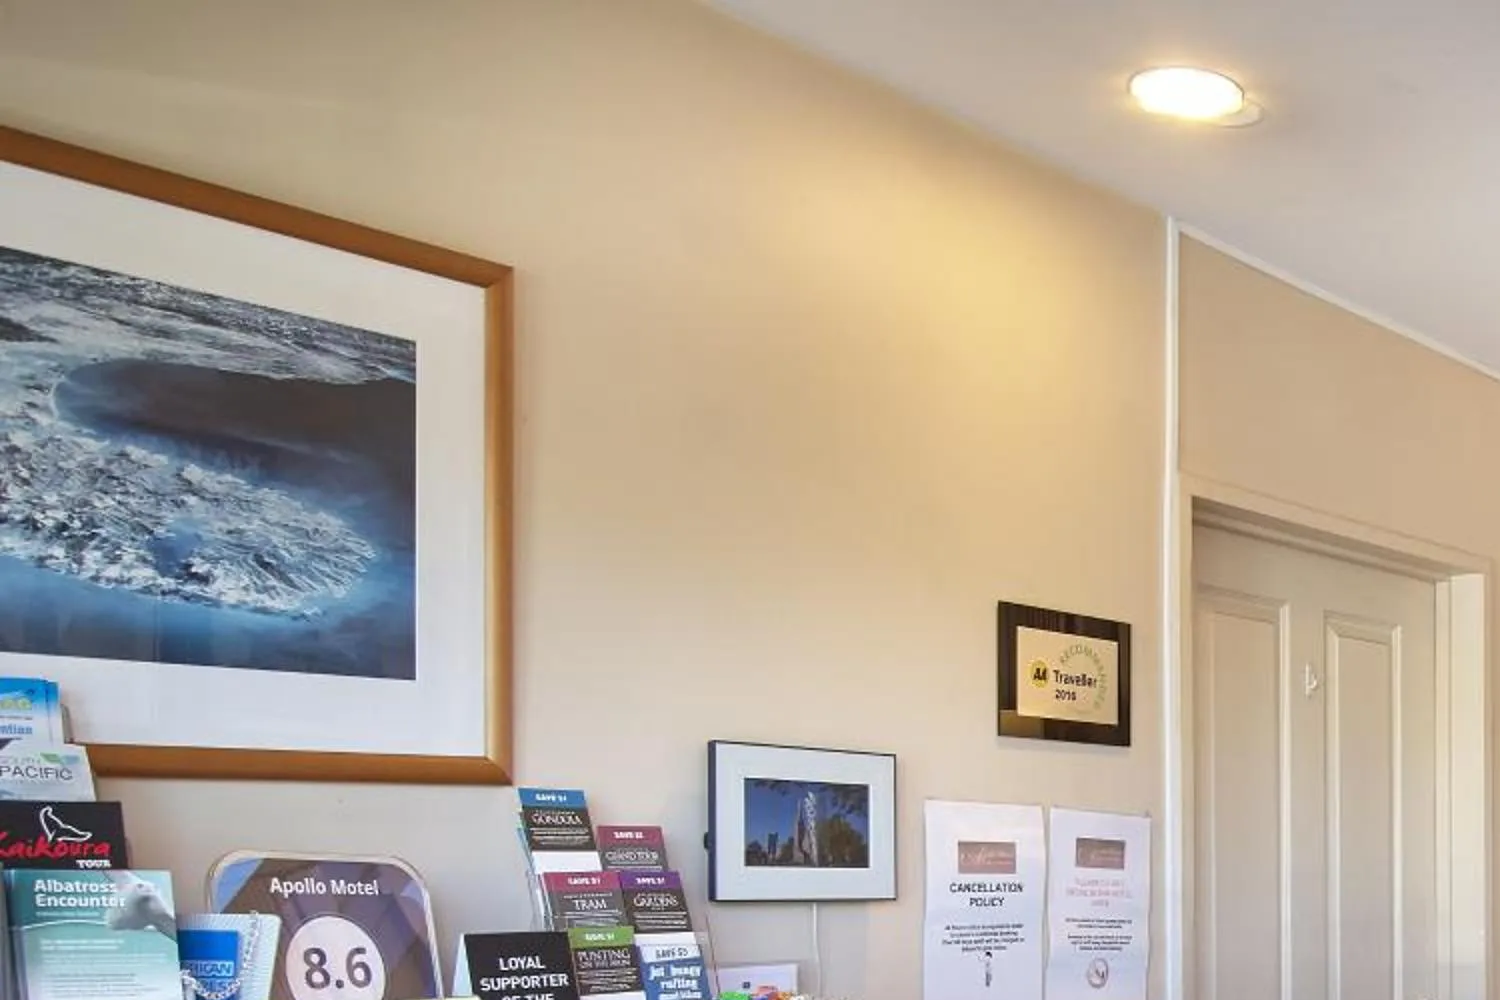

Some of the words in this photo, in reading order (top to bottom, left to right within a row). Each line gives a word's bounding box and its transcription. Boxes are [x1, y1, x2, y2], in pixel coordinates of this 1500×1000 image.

[1053, 669, 1097, 688] Traveller
[0, 765, 73, 780] PACIFIC
[34, 880, 117, 893] Albatross
[270, 877, 326, 898] Apollo
[331, 879, 379, 895] Motel
[949, 882, 1024, 893] CANCELLATION
[36, 894, 126, 907] Encounter
[575, 900, 607, 910] TRAM
[969, 897, 1005, 908] POLICY
[303, 947, 372, 990] 8.6
[499, 955, 546, 971] LOYAL
[480, 973, 569, 991] SUPPORTER
